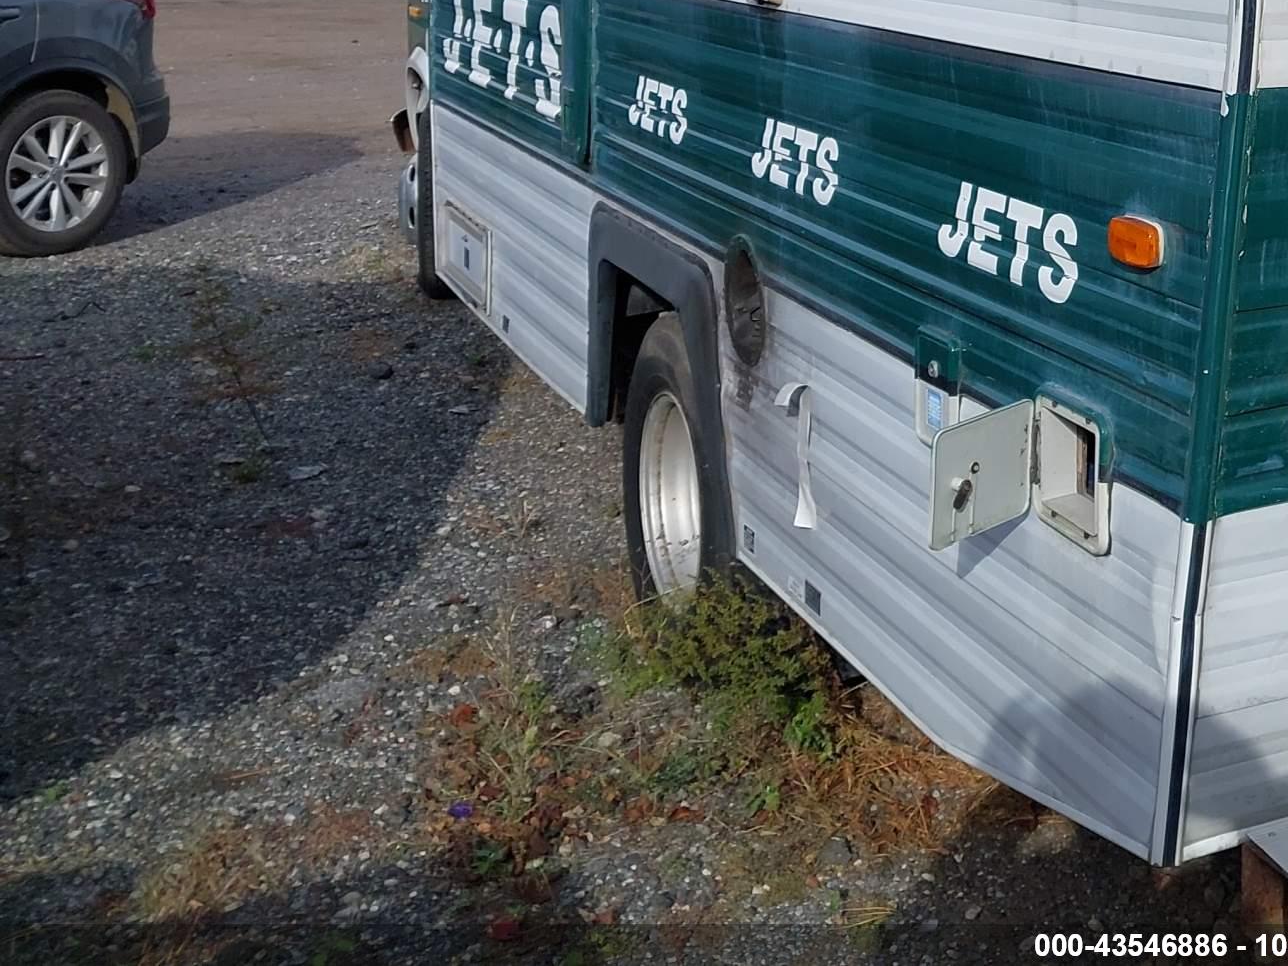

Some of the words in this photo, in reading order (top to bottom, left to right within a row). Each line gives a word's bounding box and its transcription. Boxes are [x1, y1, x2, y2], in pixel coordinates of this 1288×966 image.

[628, 75, 688, 145] JETS
[751, 117, 839, 206] JETS
[938, 181, 1078, 304] JETS
